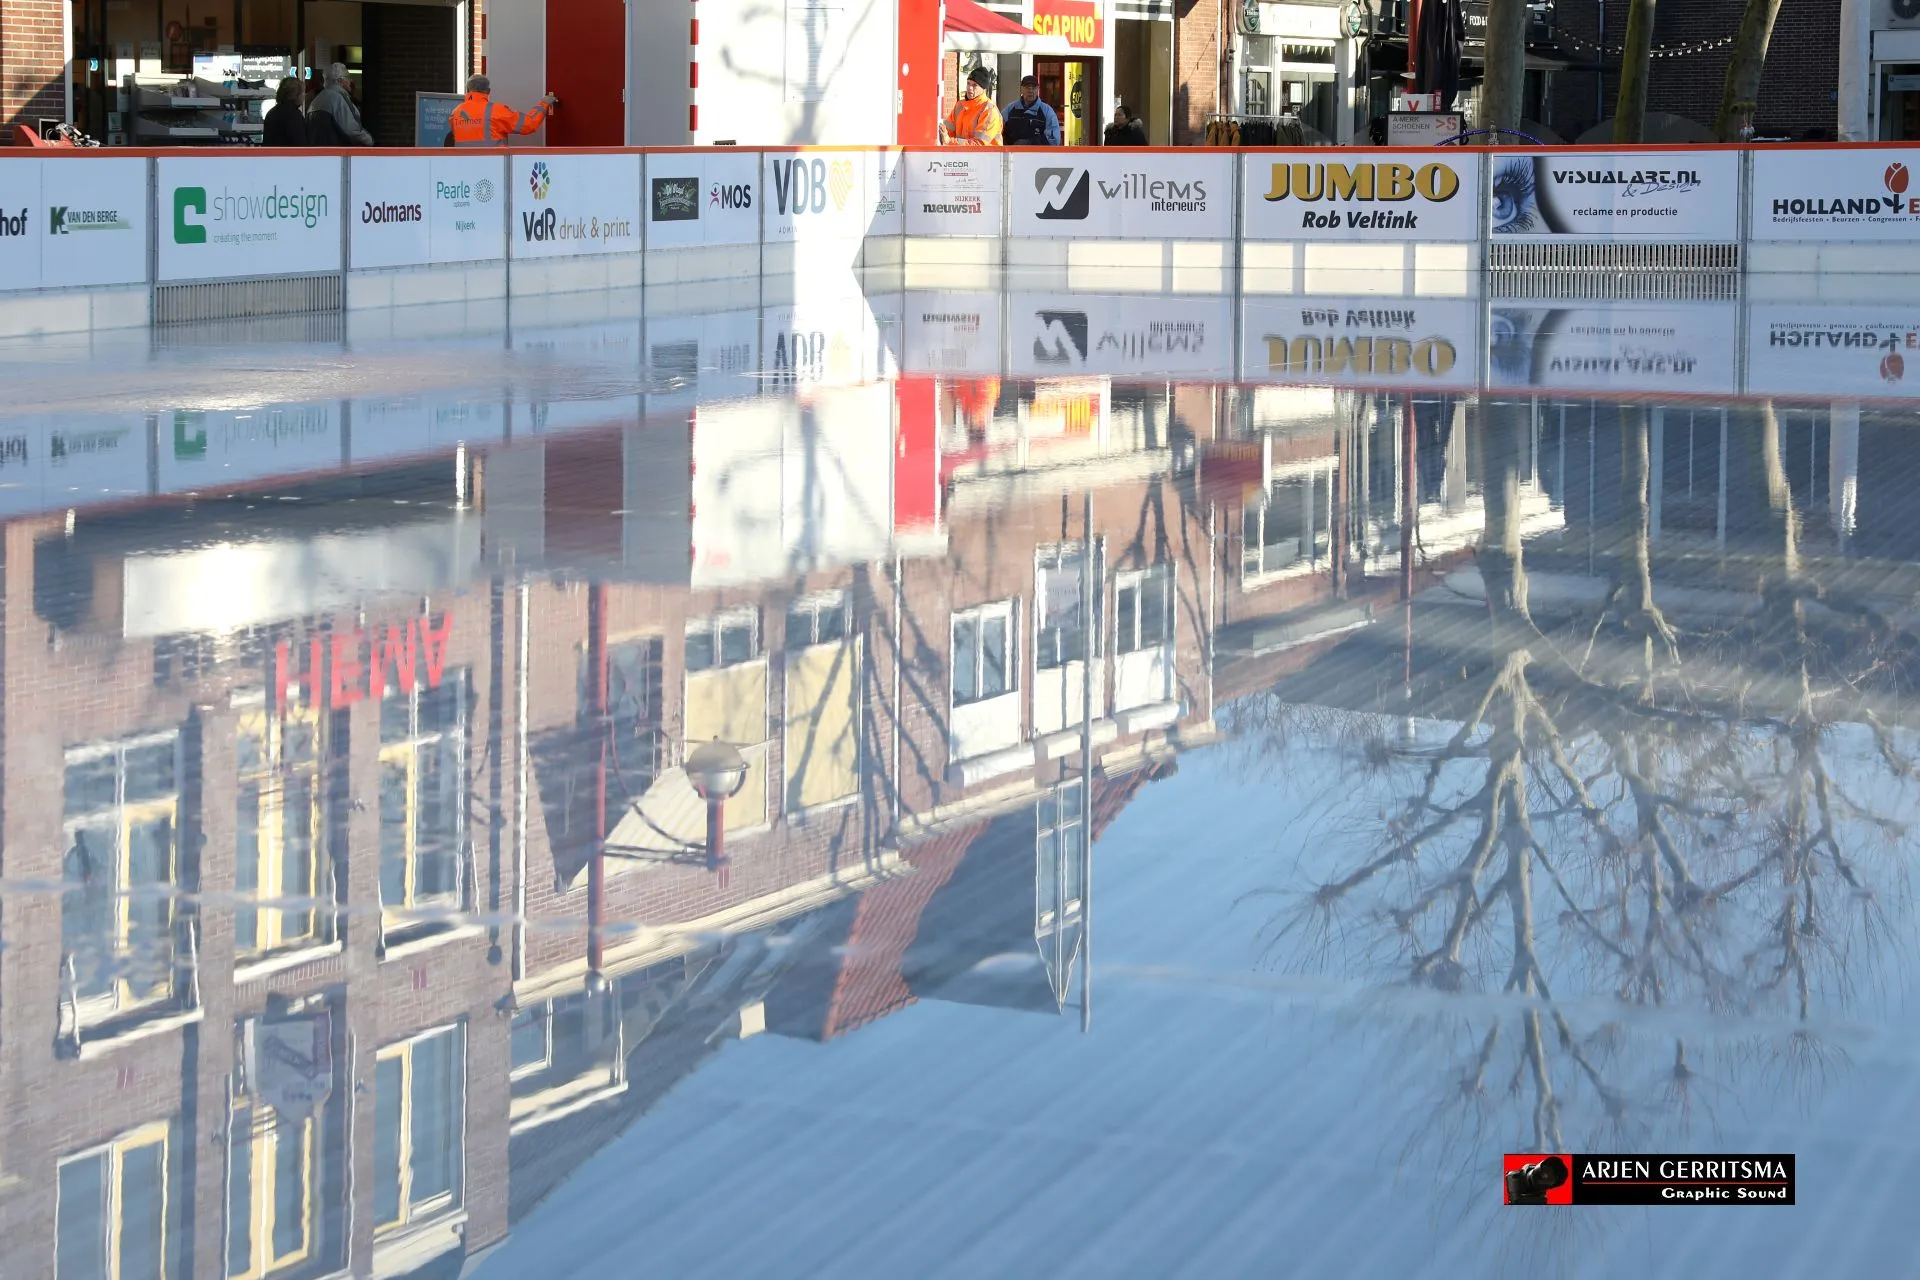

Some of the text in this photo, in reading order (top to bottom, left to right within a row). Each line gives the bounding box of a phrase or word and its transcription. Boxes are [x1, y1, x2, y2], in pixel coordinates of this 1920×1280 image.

[1034, 14, 1095, 44] SCAPINO
[1469, 15, 1481, 26] FOOD
[436, 180, 471, 199] Pearle
[773, 158, 827, 216] VDB
[1263, 162, 1460, 203] JUMBO
[213, 185, 328, 228] showdesign
[721, 184, 752, 209] MOS
[1151, 198, 1206, 212] interieurs
[1772, 199, 1881, 215] HOLLAND
[0, 208, 28, 236] hof
[67, 211, 81, 223] VAN
[82, 211, 96, 222] DEN
[96, 210, 118, 222] BERGE
[362, 201, 422, 224] Dolmans
[1302, 210, 1419, 229] Rob Veltink
[1572, 208, 1614, 216] reclame
[1630, 207, 1678, 217] productie
[455, 220, 476, 232] Nijkerk
[522, 208, 631, 245] VdR druk & print
